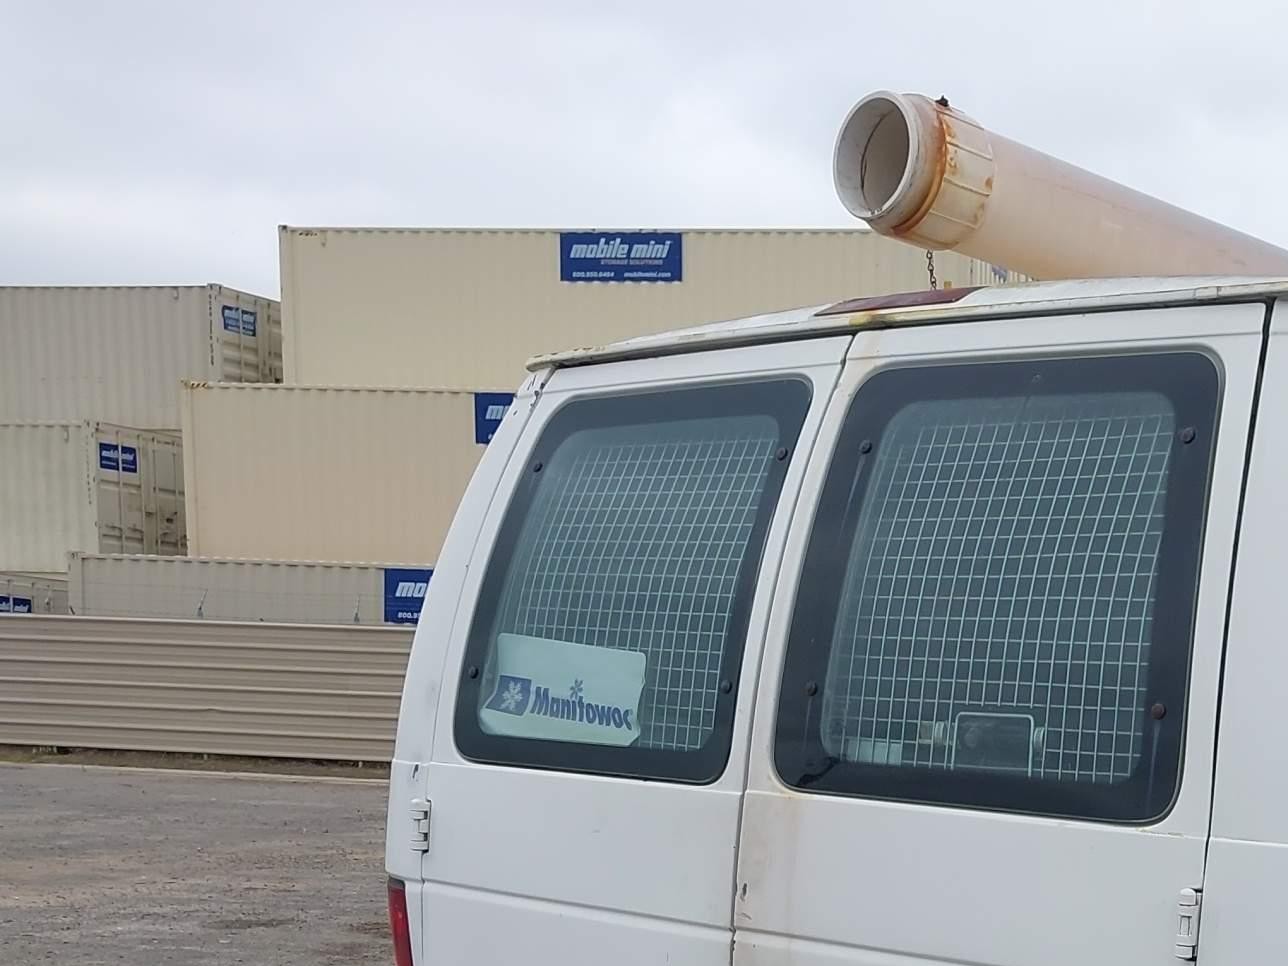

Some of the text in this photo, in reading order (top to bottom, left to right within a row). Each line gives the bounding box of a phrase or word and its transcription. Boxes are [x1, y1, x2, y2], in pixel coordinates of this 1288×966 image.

[569, 238, 671, 259] mobile mini
[530, 686, 632, 731] Manitowoc
